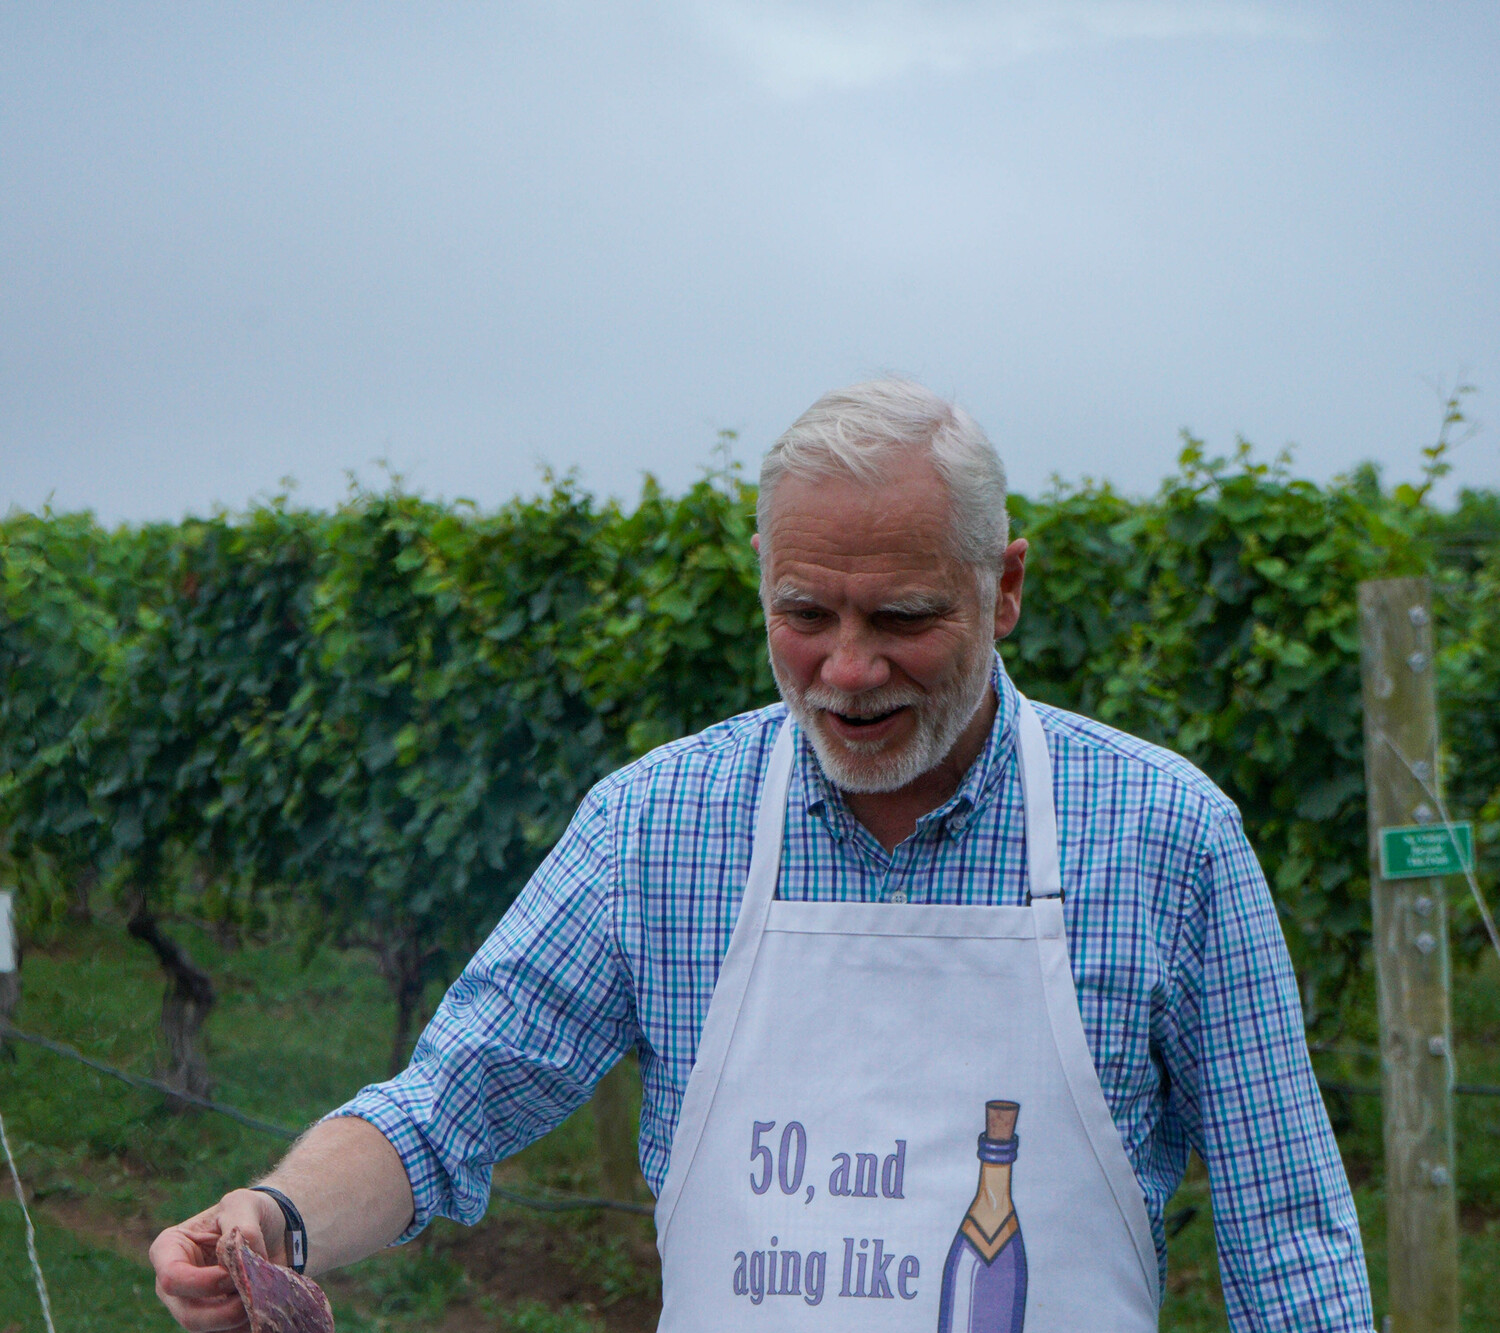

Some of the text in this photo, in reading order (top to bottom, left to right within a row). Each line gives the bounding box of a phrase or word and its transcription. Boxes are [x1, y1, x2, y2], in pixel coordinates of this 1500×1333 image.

[750, 1121, 906, 1204] 50, and
[733, 1236, 919, 1306] aging like
